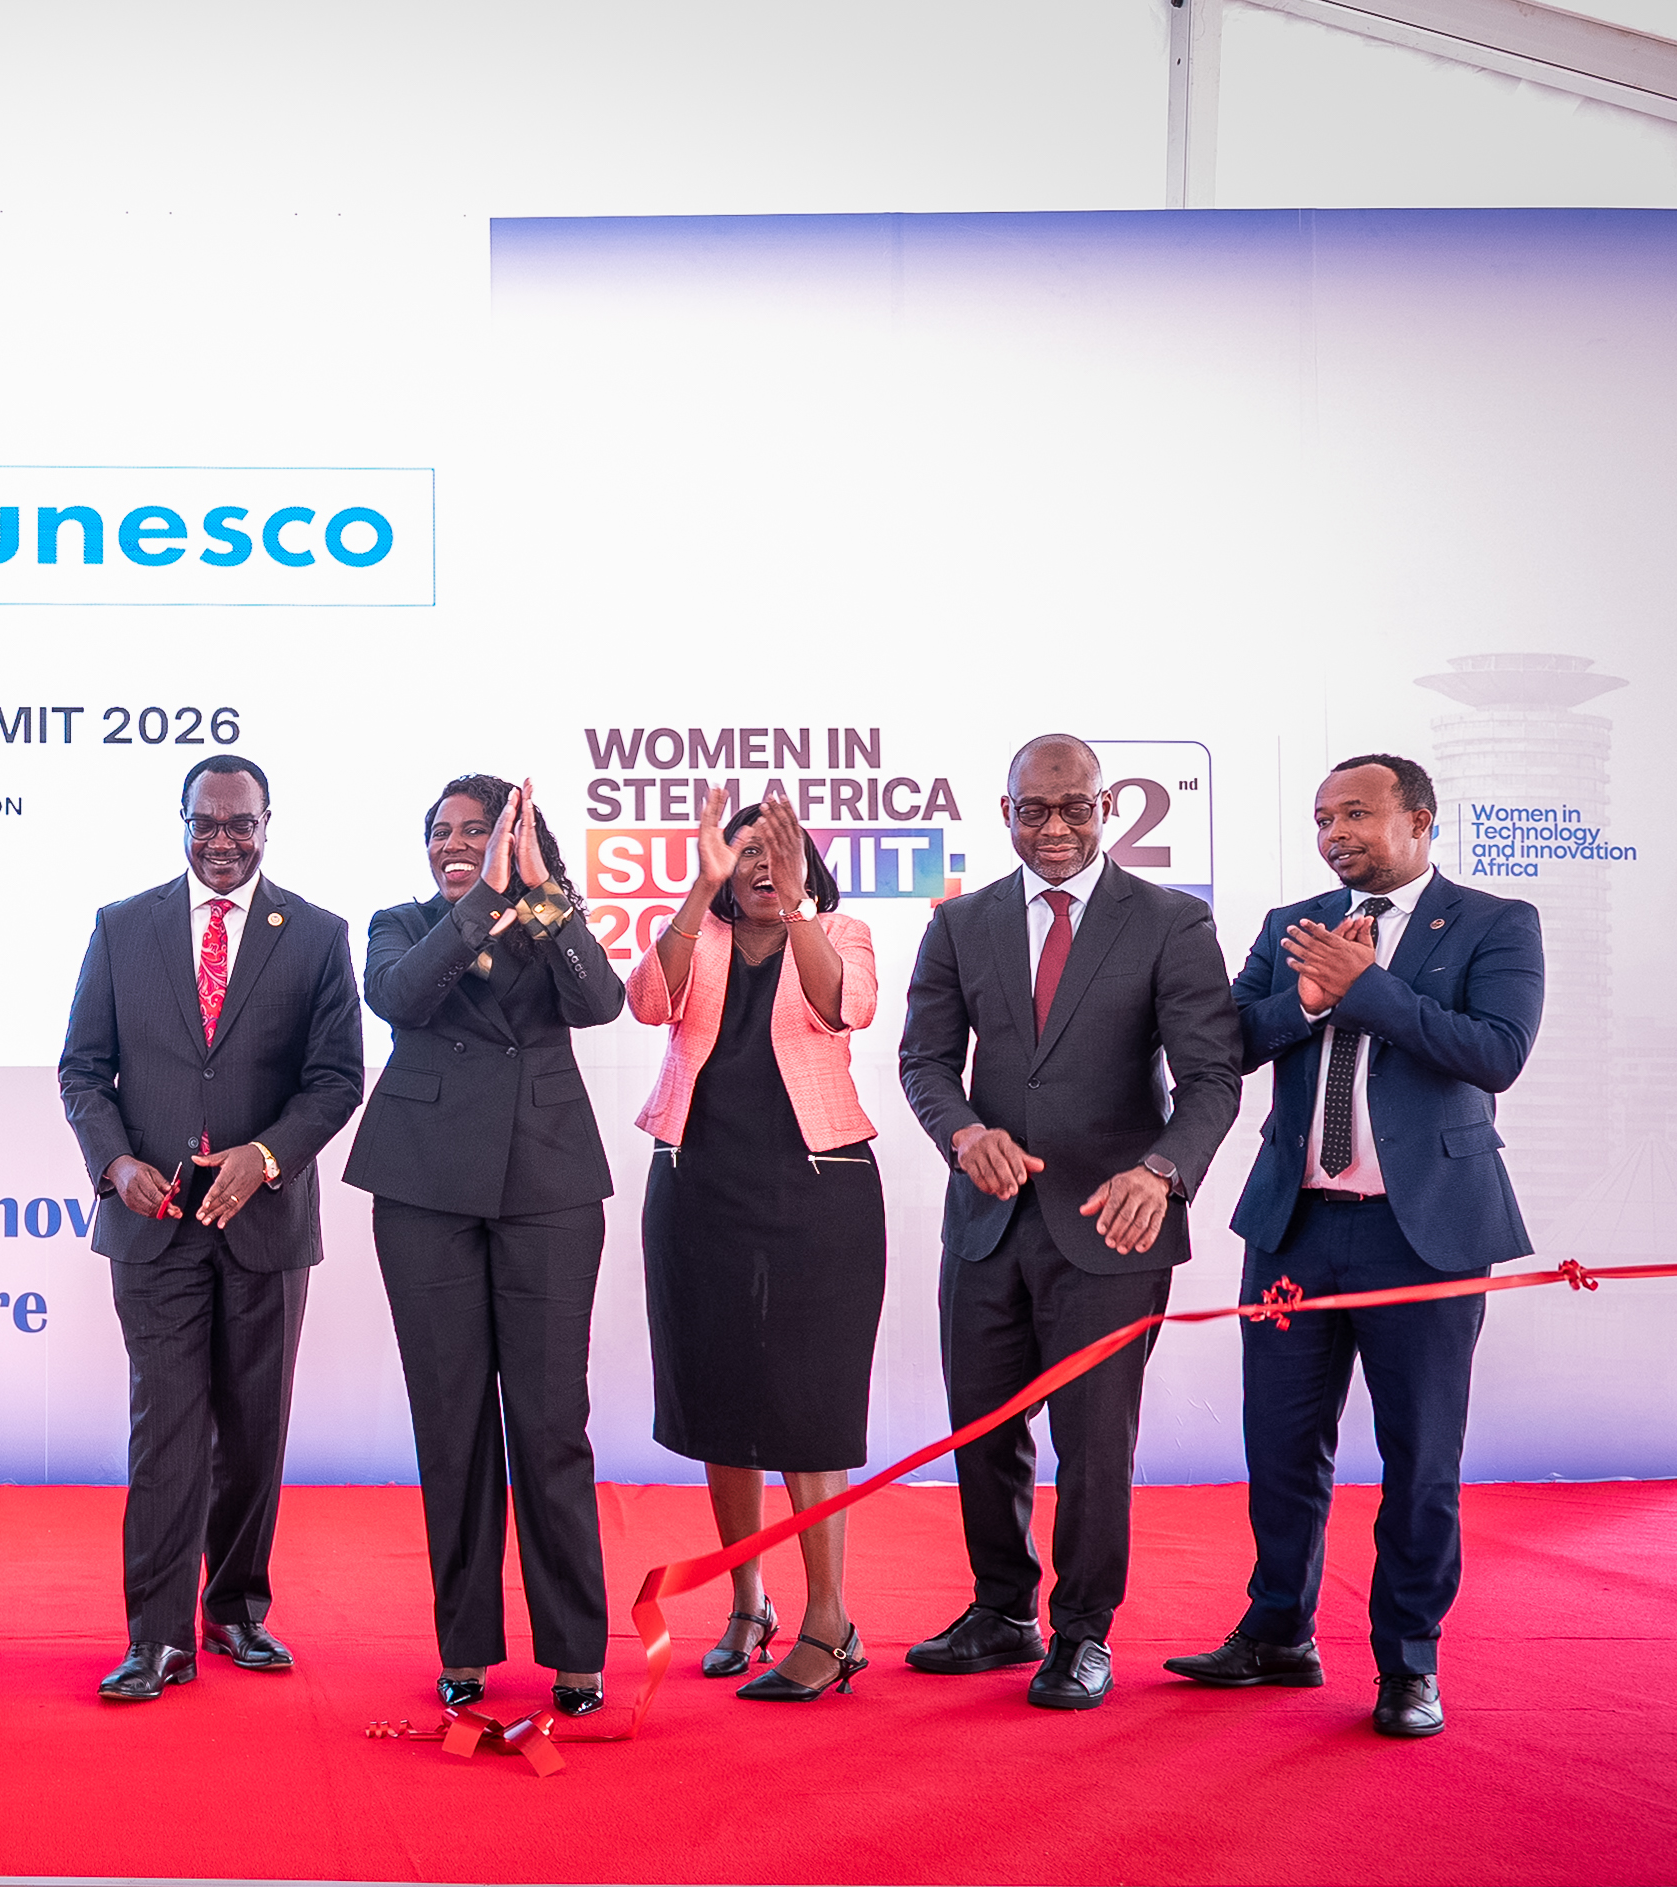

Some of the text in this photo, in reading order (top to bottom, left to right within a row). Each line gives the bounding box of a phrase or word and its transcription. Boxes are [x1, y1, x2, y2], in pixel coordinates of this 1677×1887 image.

[102, 706, 241, 745] 2026
[584, 728, 881, 770] WOMEN IN
[585, 778, 741, 821] STEM
[1471, 804, 1581, 823] Women in
[1471, 822, 1601, 846] Technology
[596, 836, 930, 895] SUMIT
[1472, 841, 1637, 860] and innovation
[1472, 858, 1539, 876] Africa
